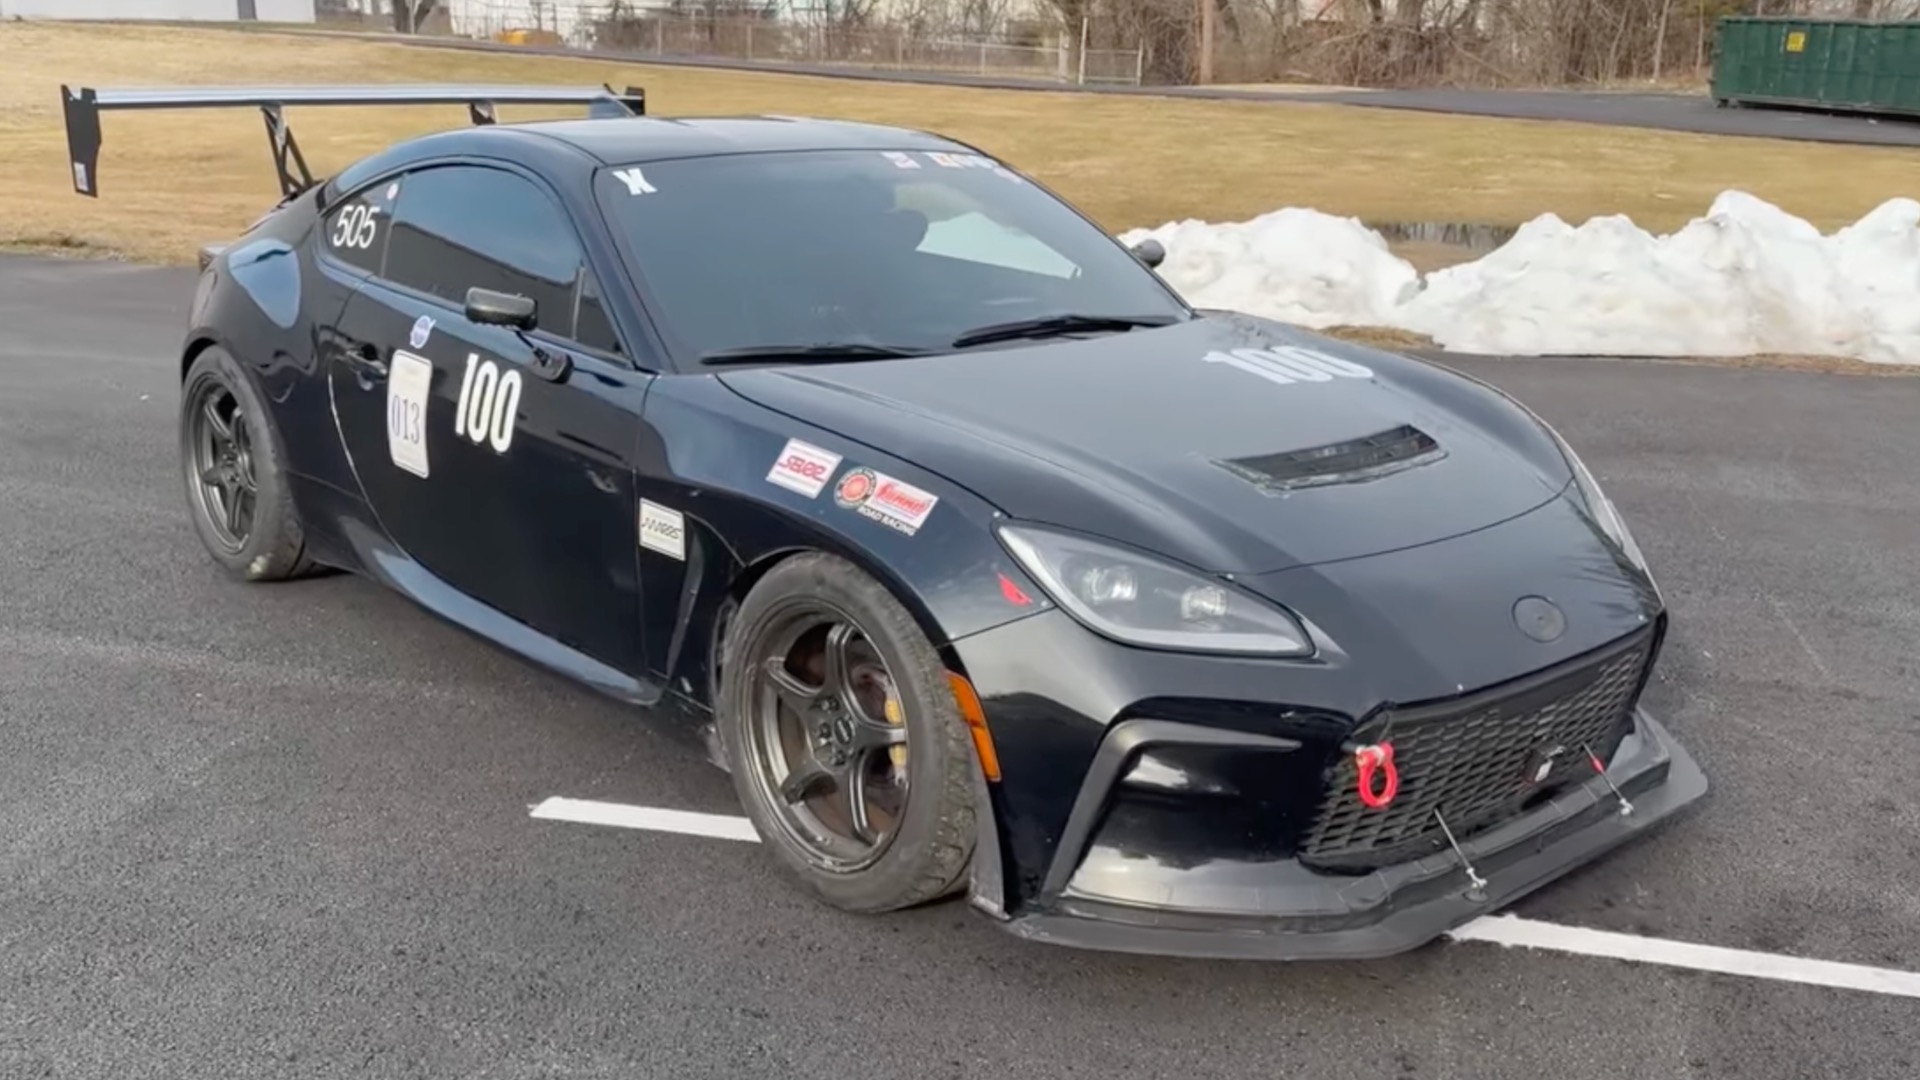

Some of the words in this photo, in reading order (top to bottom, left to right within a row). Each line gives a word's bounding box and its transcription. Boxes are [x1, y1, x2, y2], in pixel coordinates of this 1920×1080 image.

[612, 168, 658, 195] X
[333, 205, 380, 248] 505
[1202, 346, 1374, 384] 100
[392, 394, 420, 444] 013
[455, 353, 522, 453] 100
[857, 505, 882, 521] ROAD
[881, 514, 917, 537] RACING
